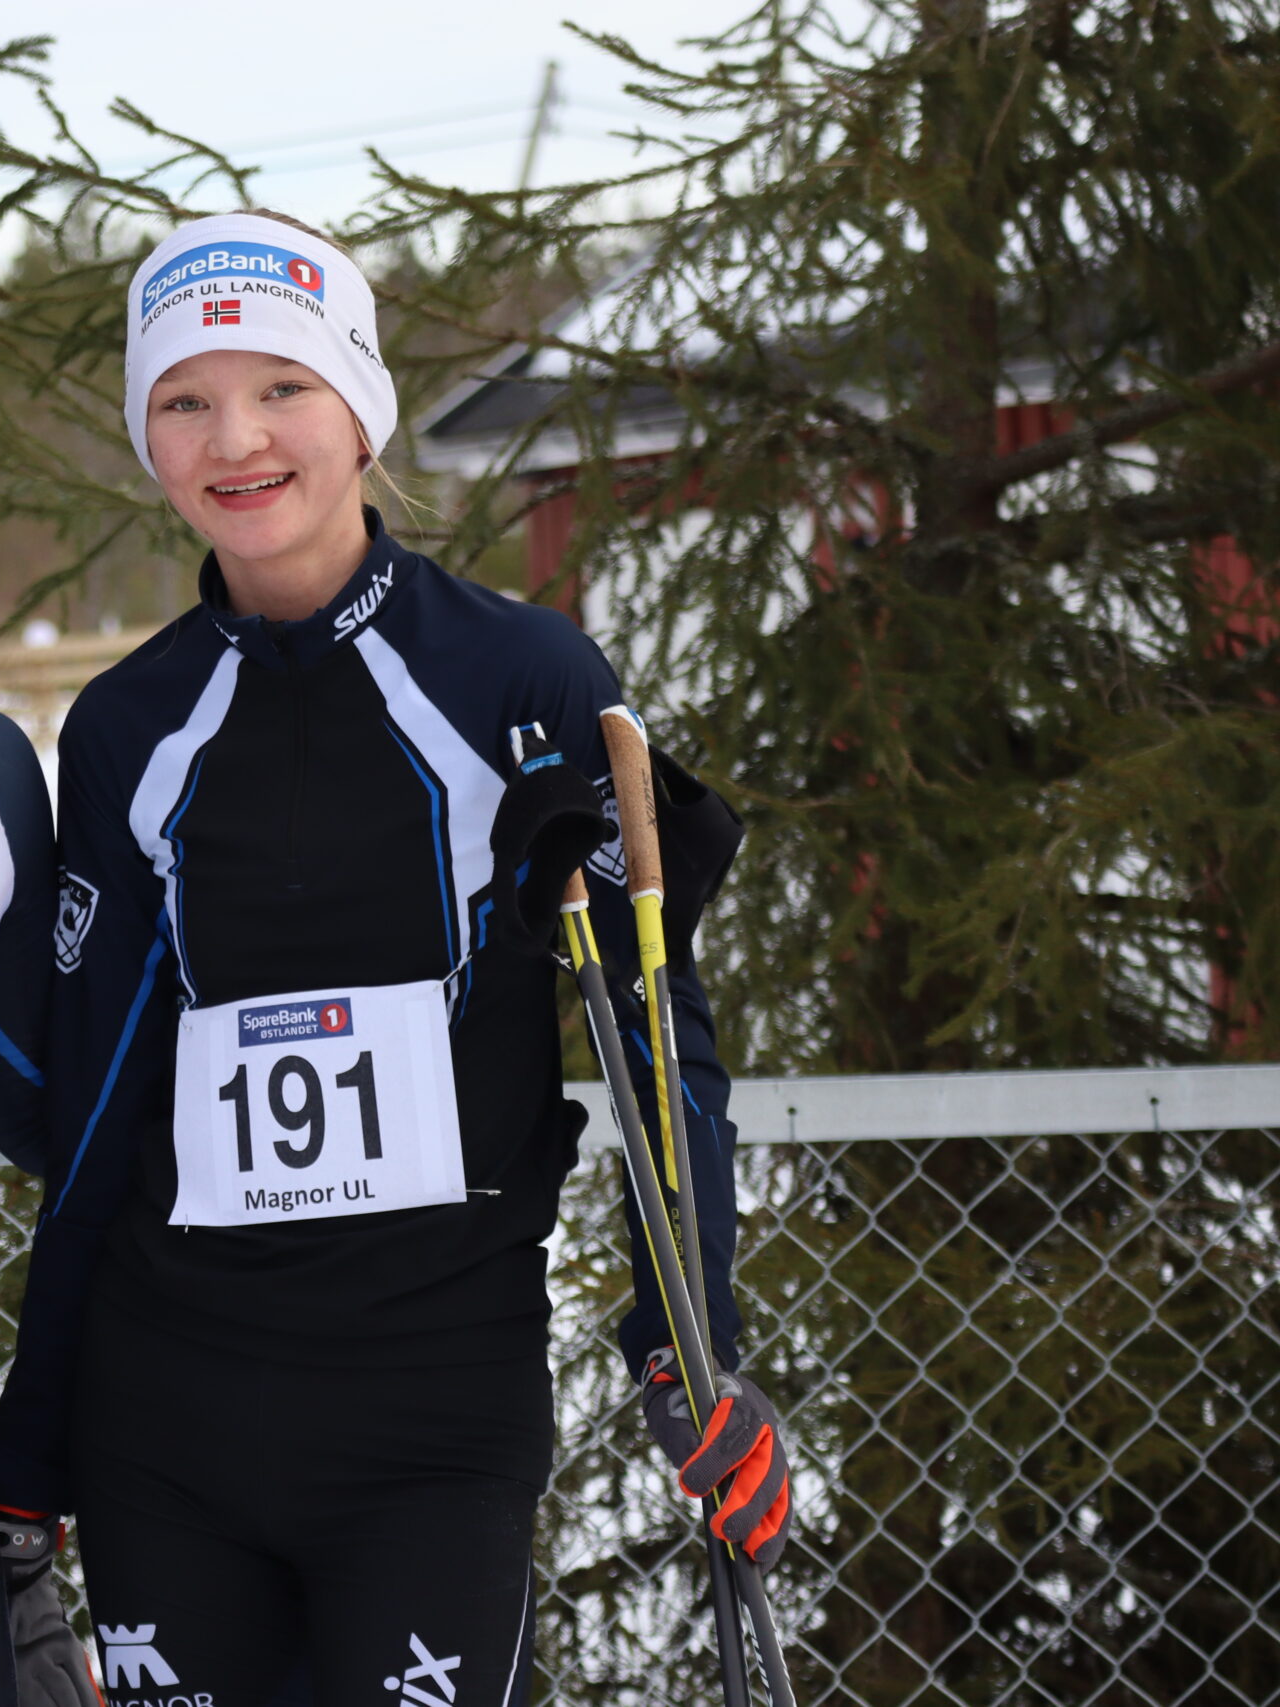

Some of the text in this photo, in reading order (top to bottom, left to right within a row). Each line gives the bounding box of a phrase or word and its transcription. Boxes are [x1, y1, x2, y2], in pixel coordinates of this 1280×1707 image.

[144, 250, 285, 307] SpareBank
[140, 281, 326, 338] MAGNOR UL LANGRENN
[243, 1007, 317, 1031] SpareBank
[260, 1024, 318, 1039] ØSTLANDET
[219, 1050, 383, 1173] 191
[244, 1178, 376, 1212] Magnor UL
